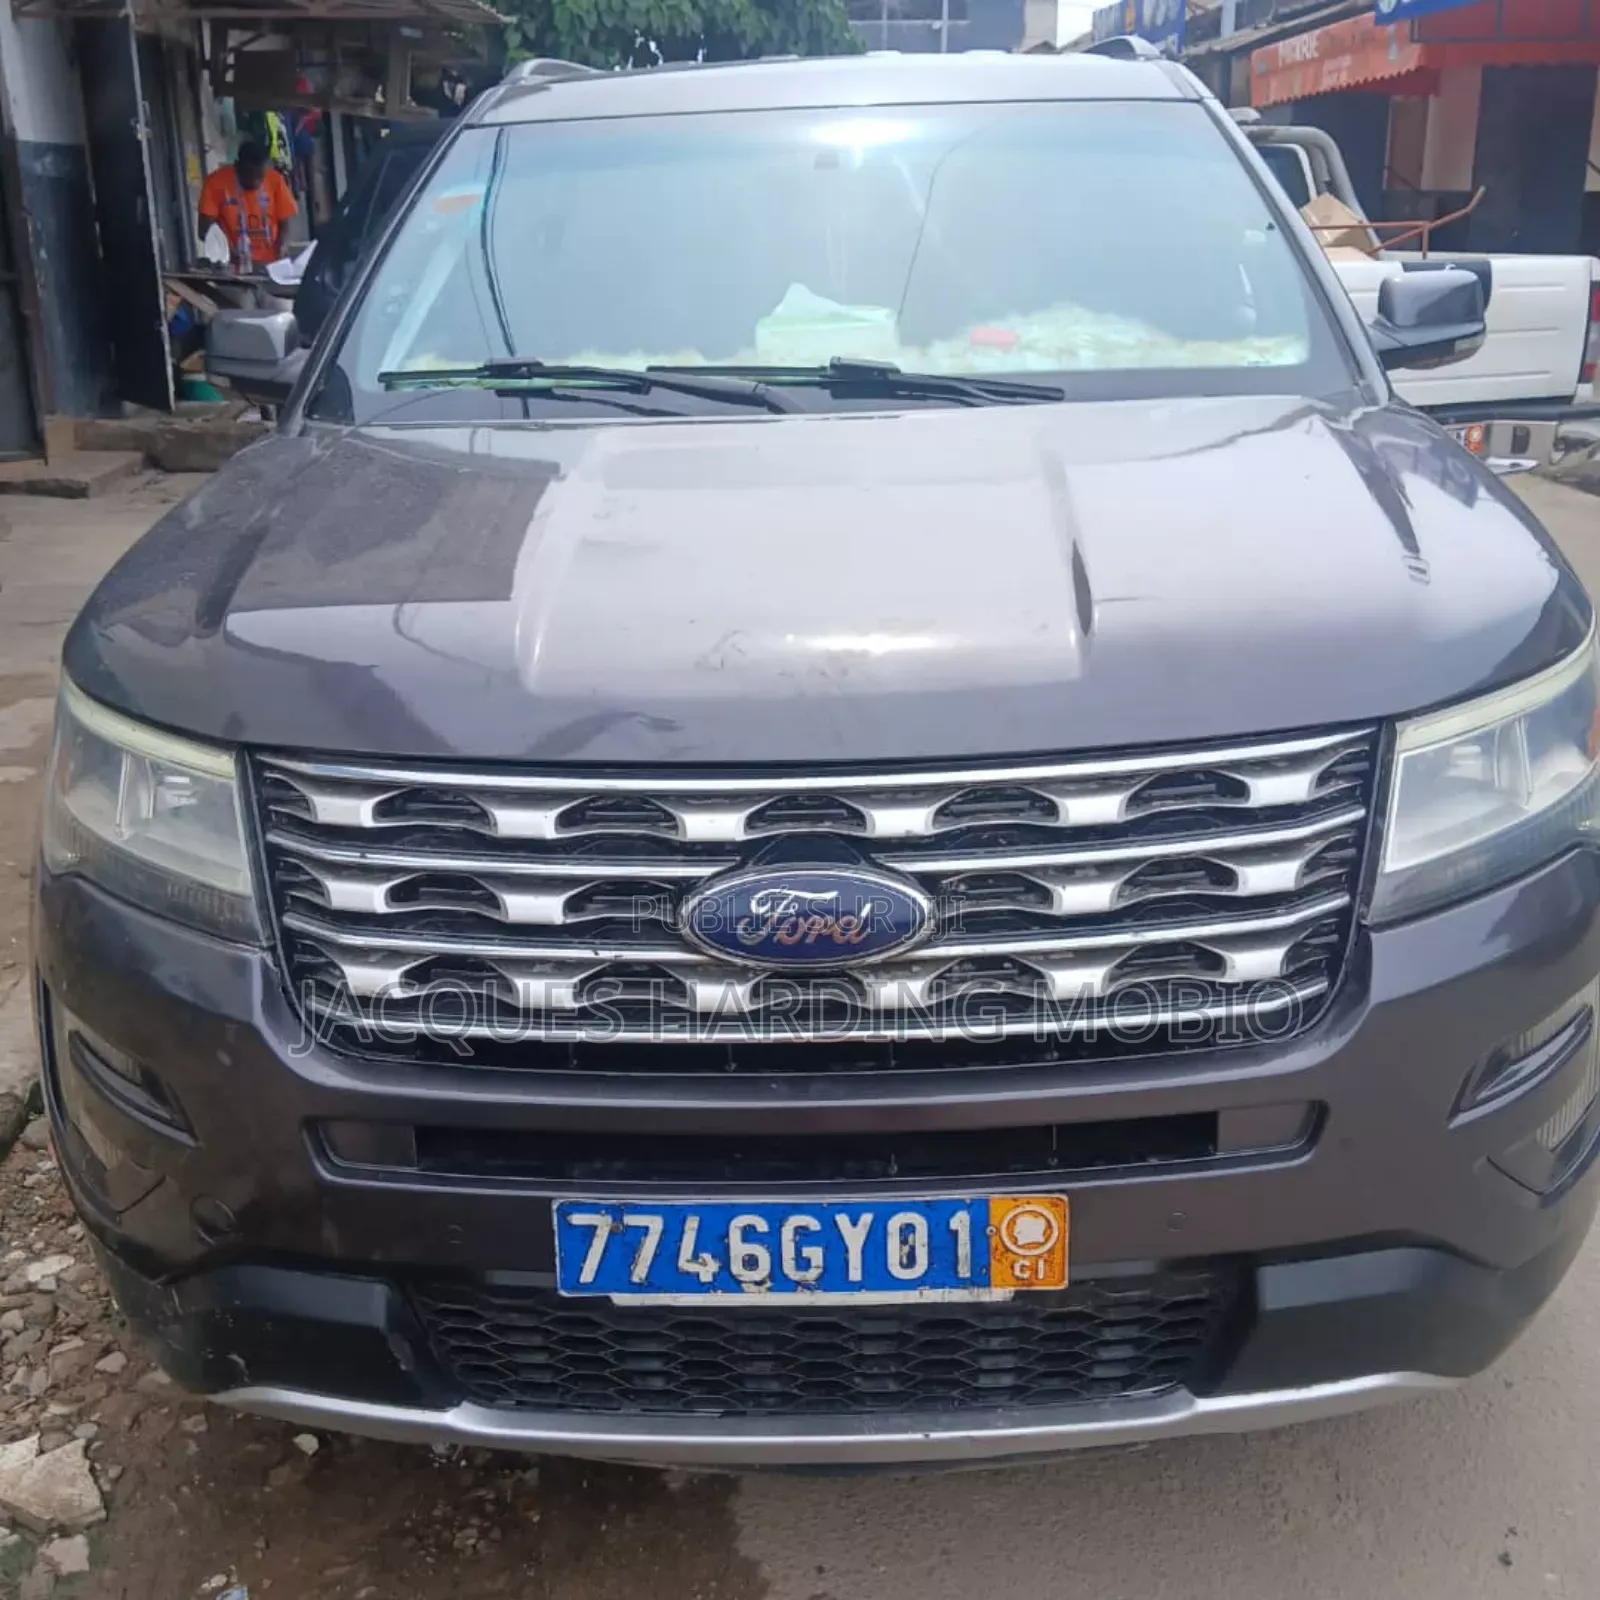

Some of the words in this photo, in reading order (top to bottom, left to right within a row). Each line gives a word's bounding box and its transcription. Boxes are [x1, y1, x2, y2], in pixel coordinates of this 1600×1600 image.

[736, 889, 872, 945] Ford
[566, 1211, 971, 1283] 7746GY01
[1012, 1259, 1045, 1280] CI
